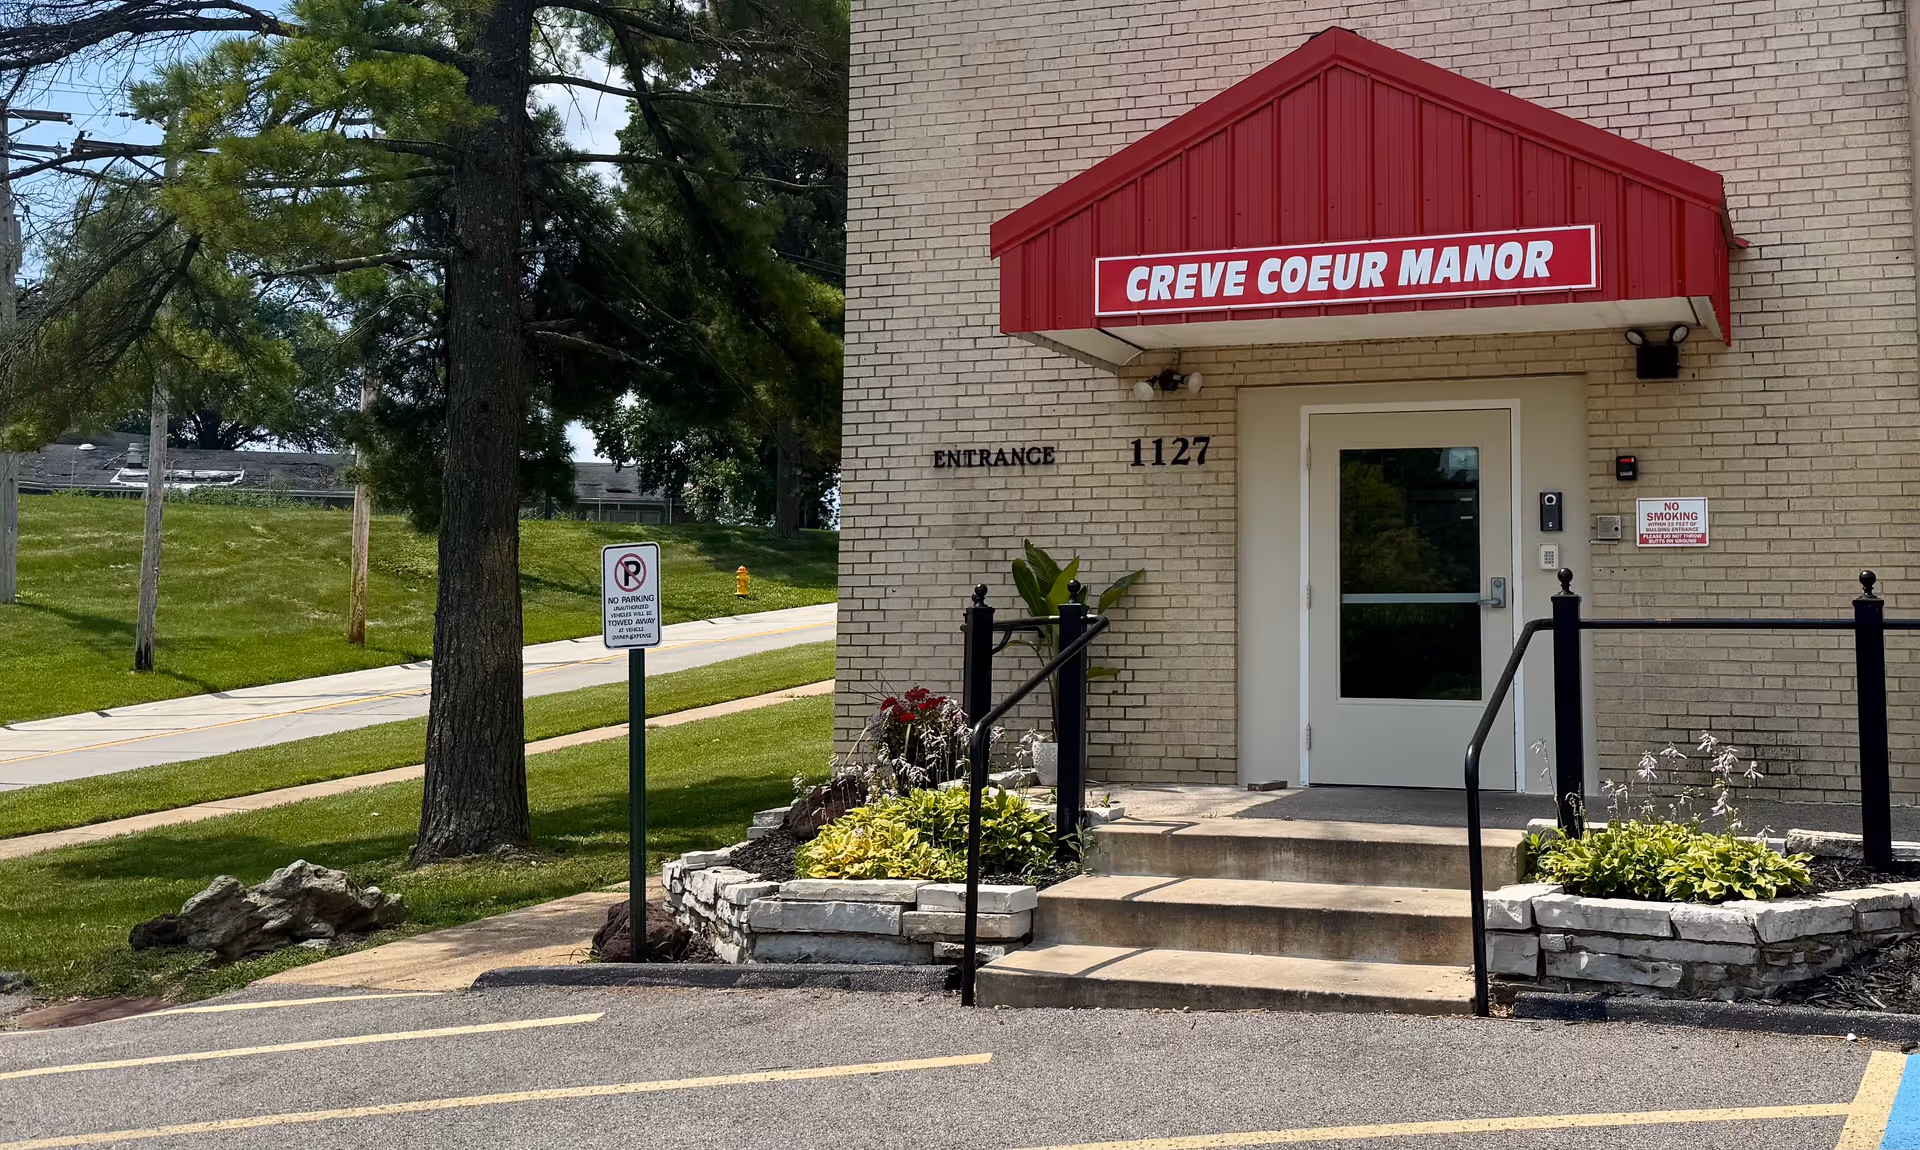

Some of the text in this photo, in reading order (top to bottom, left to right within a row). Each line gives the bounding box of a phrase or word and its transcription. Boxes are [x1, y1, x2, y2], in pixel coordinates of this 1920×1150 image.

[1126, 240, 1554, 302] CREVE COEUR MANOR
[933, 446, 1055, 468] ENTRANCE
[1130, 436, 1211, 467] 1127
[1646, 512, 1698, 521] SMOKING
[1664, 502, 1680, 511] NO
[624, 561, 640, 586] P
[622, 594, 654, 603] PARKING
